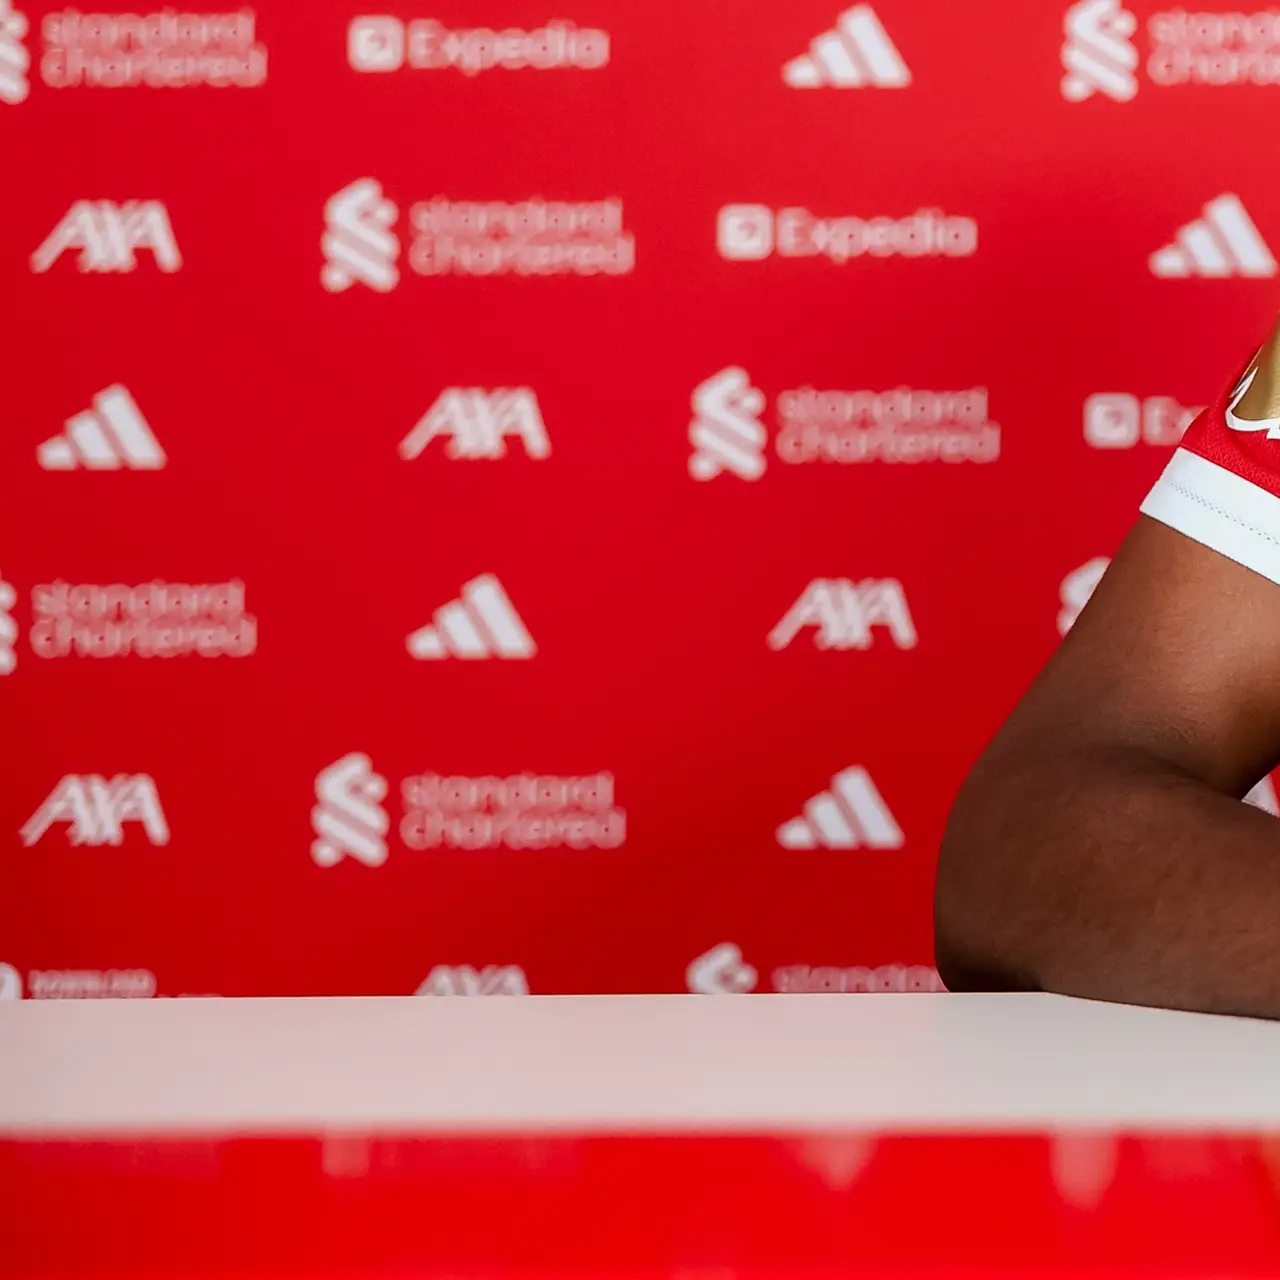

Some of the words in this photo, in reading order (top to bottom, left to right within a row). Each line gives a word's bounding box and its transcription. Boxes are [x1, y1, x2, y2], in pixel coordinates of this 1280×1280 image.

[406, 18, 610, 76] Expedia
[30, 199, 182, 273] AXA
[775, 207, 978, 264] Expedia
[399, 386, 551, 460] AXA
[768, 578, 918, 650] AXA
[19, 773, 170, 846] AXA
